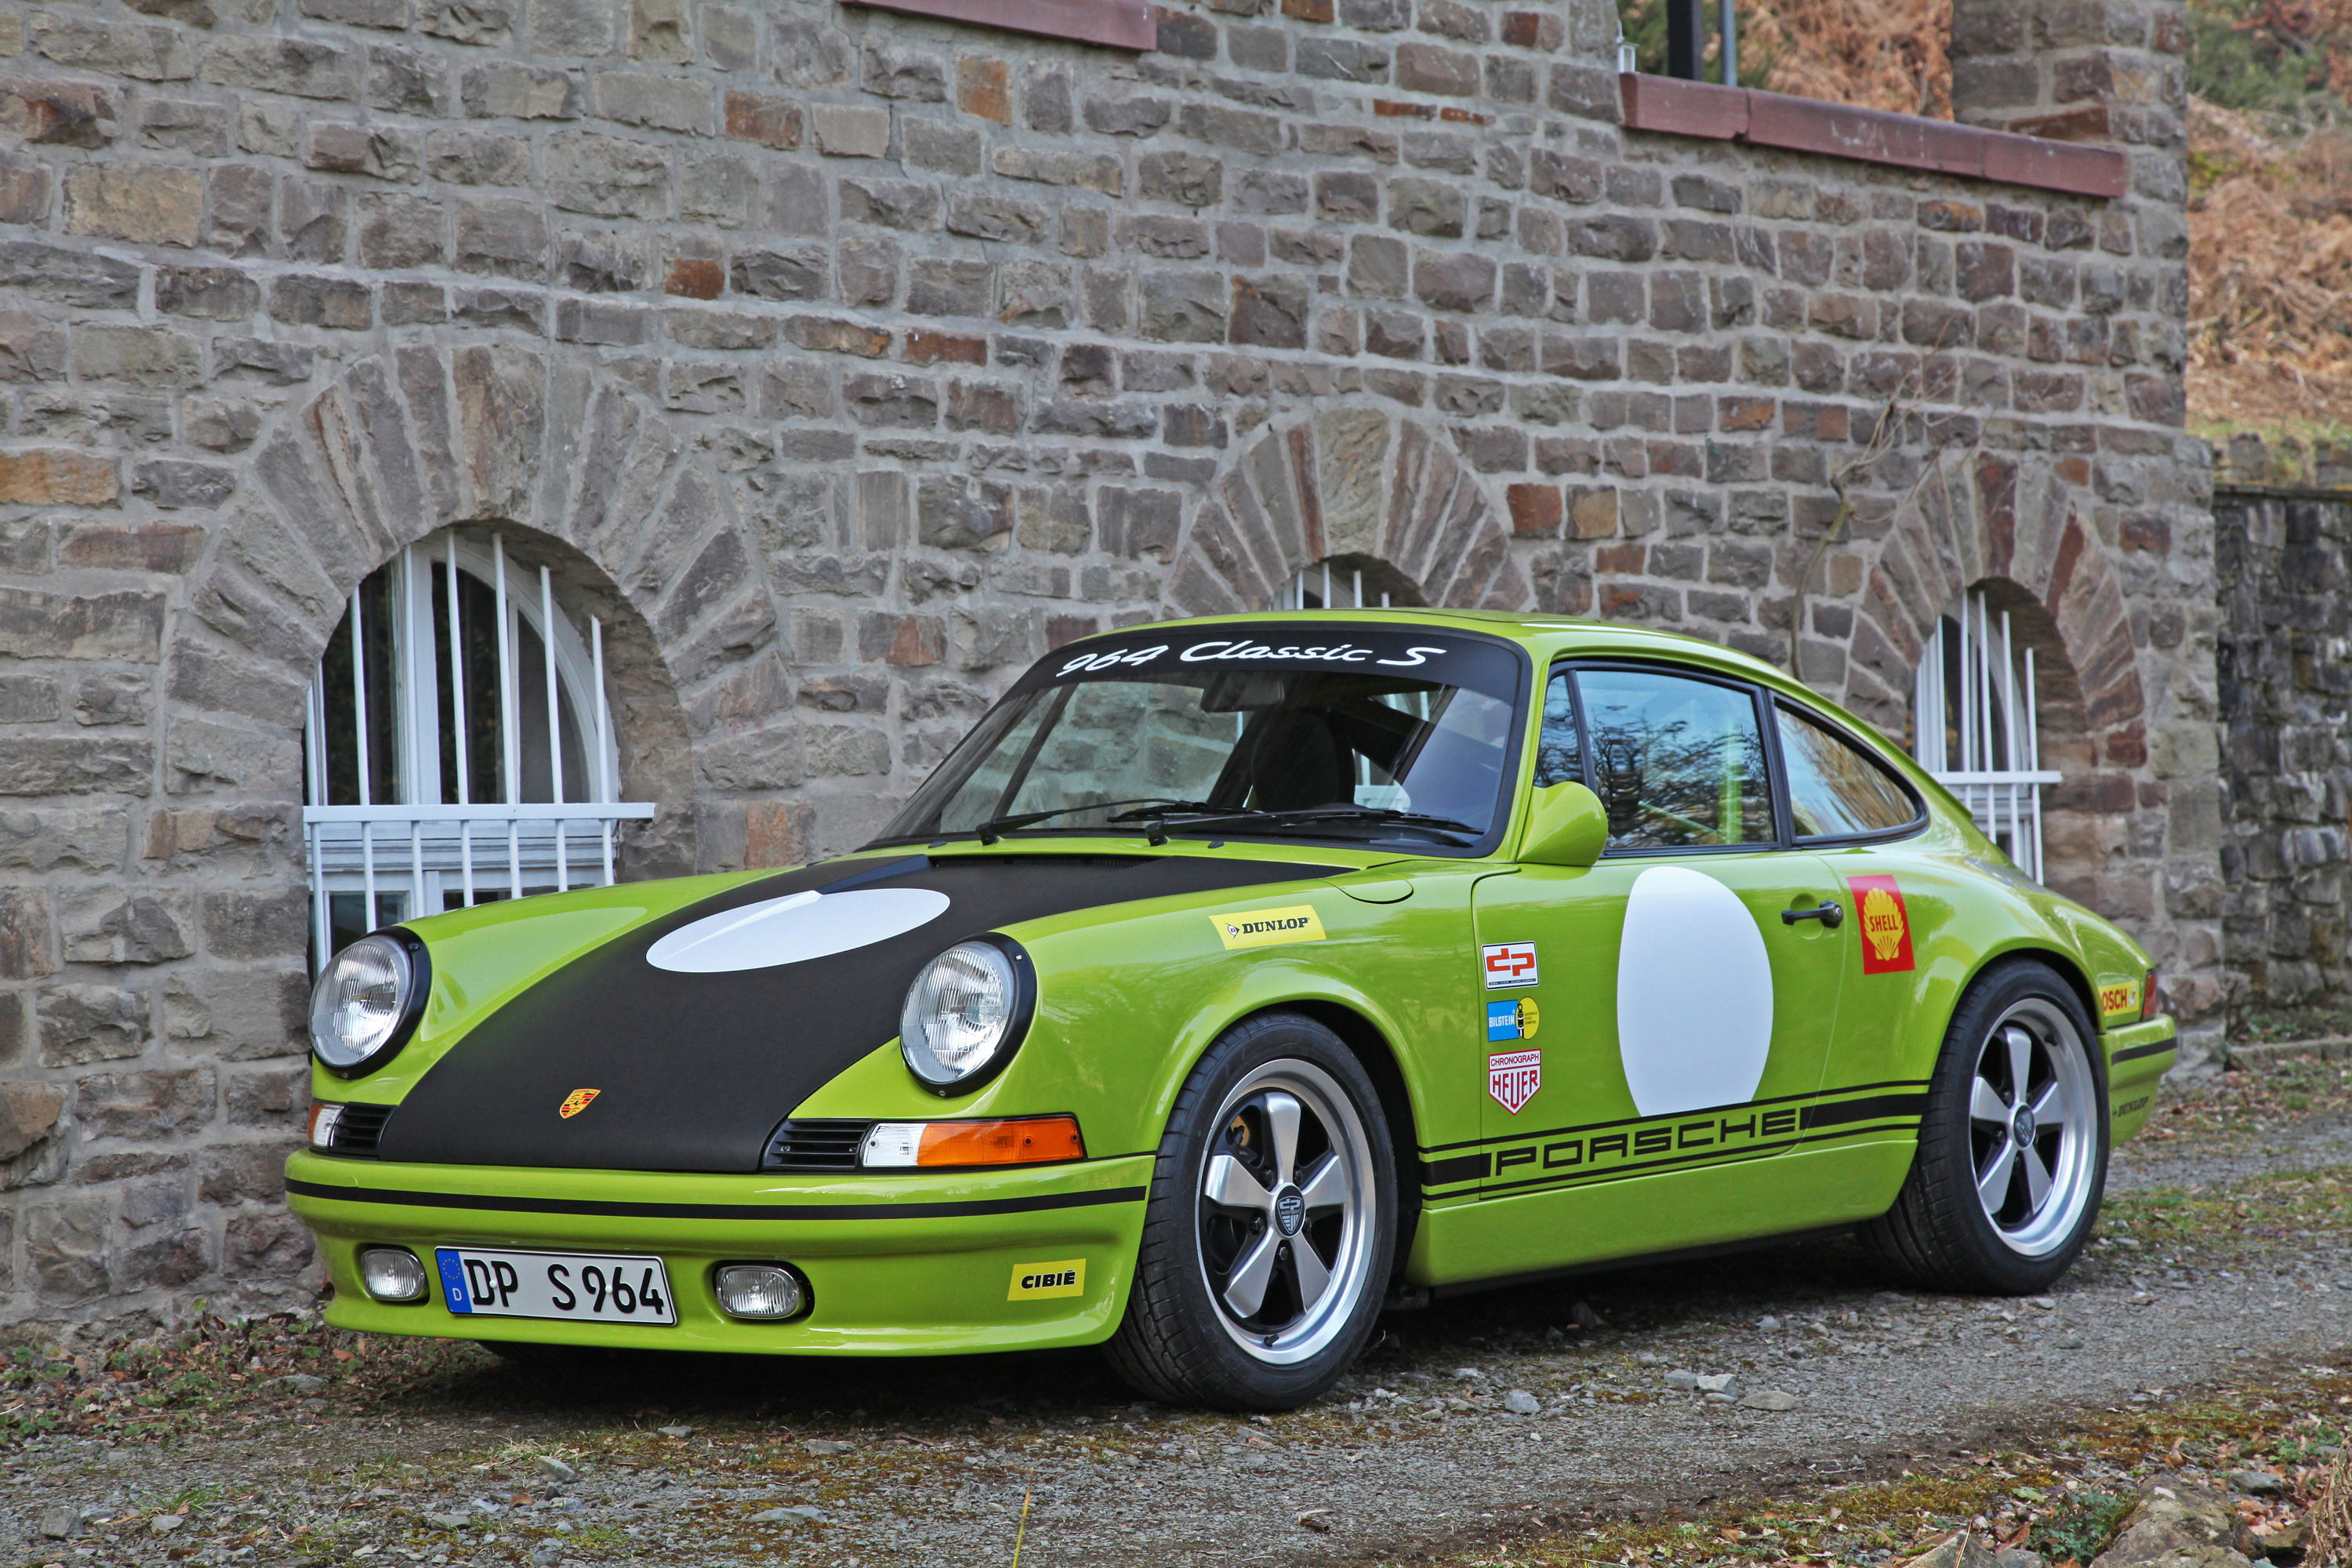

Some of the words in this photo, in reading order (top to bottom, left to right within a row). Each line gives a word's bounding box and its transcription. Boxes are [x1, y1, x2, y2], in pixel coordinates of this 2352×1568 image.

[1056, 644, 1169, 677] 964
[1180, 640, 1373, 662] Classic
[1377, 647, 1446, 666] S
[1242, 916, 1308, 935] DUNLOP
[1869, 914, 1899, 932] SHELL
[2101, 988, 2127, 1011] OSCH
[1489, 1014, 1515, 1027] BILSTEIN
[1490, 1053, 1539, 1067] CHRONOGRAPH
[1492, 1069, 1538, 1109] HEUER
[1495, 1108, 1797, 1176] PORSCHE
[463, 1258, 518, 1308] DP
[452, 1287, 463, 1301] D
